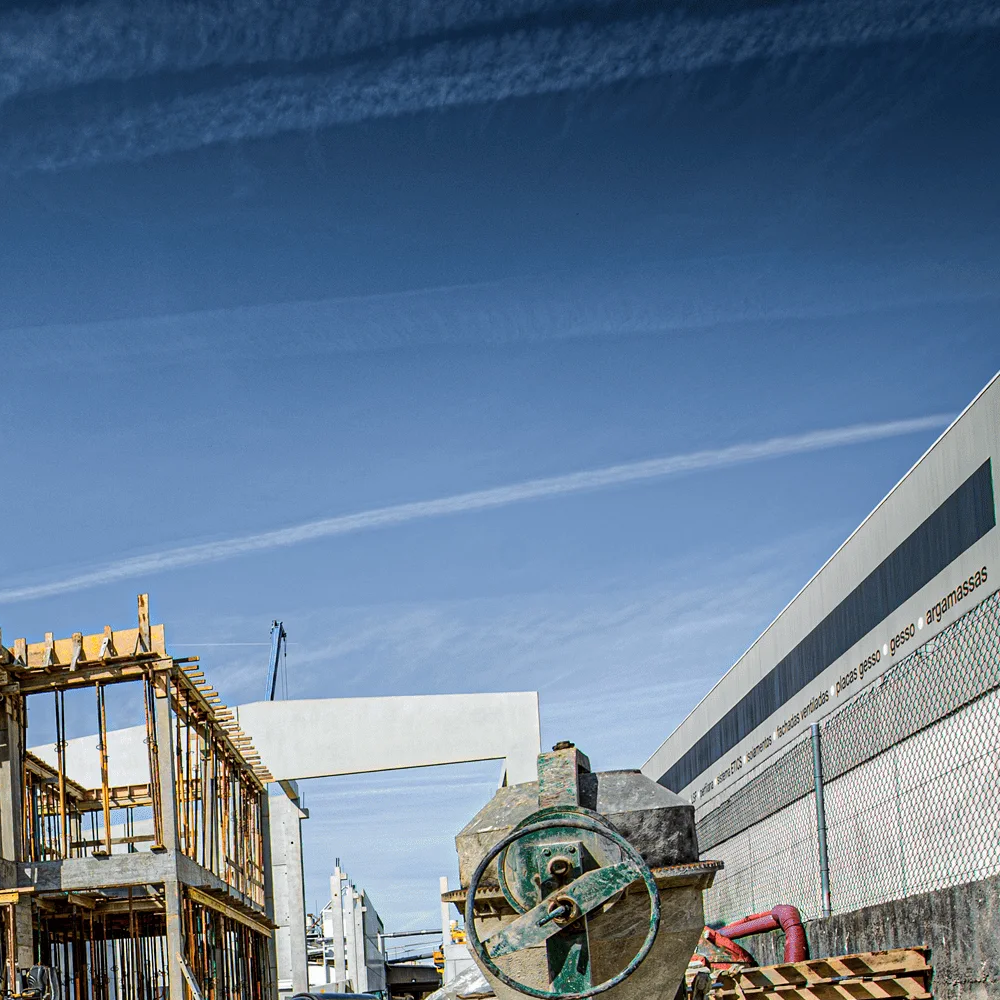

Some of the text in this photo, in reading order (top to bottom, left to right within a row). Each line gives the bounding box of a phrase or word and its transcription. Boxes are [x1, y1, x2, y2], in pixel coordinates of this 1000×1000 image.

[776, 713, 800, 739] fachadas
[800, 690, 829, 720] ventiladas
[835, 667, 858, 697] placas
[859, 650, 881, 680] gesso
[890, 623, 915, 656] gesso
[926, 566, 988, 625] argamassas
